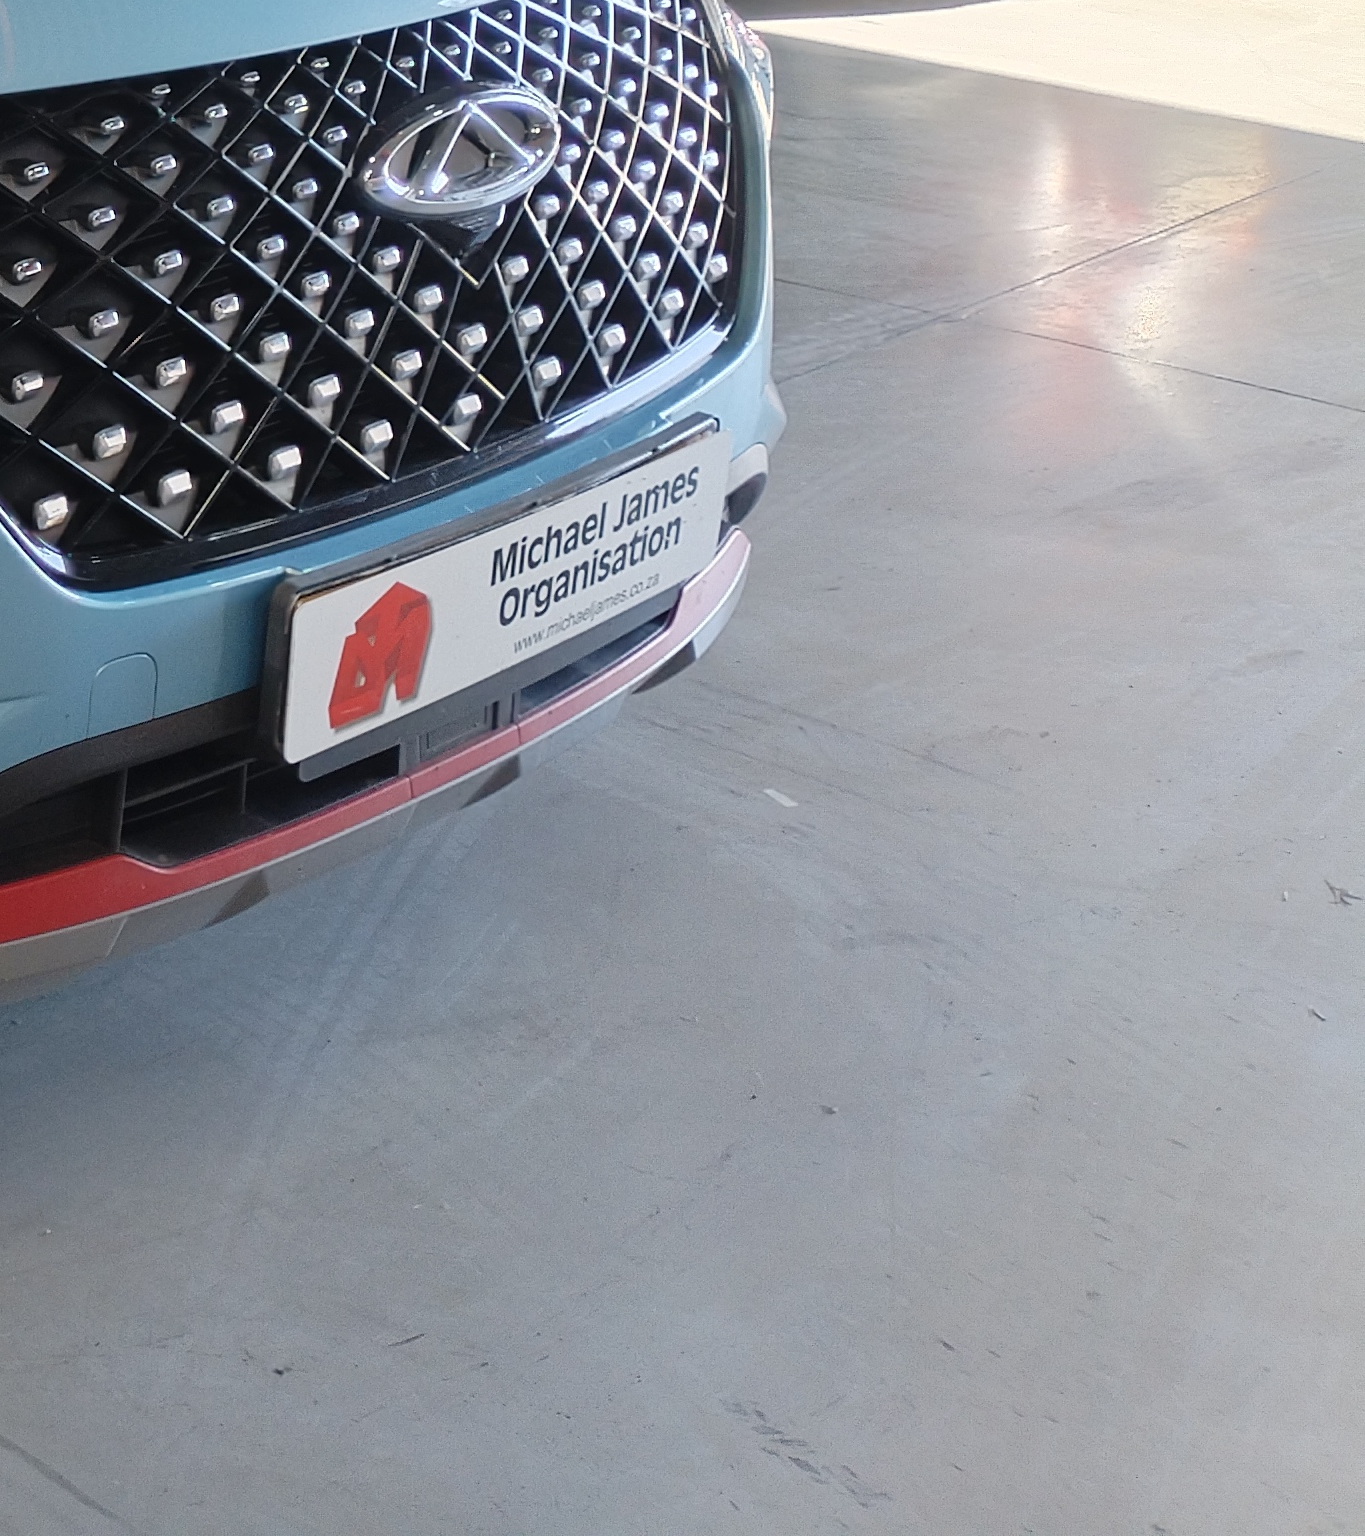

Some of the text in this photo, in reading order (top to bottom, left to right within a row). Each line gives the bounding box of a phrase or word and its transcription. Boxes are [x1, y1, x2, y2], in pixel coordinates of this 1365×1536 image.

[490, 466, 699, 586] Michael James
[499, 517, 681, 626] Organisation
[513, 573, 660, 653] www.michaeljames.co.za
